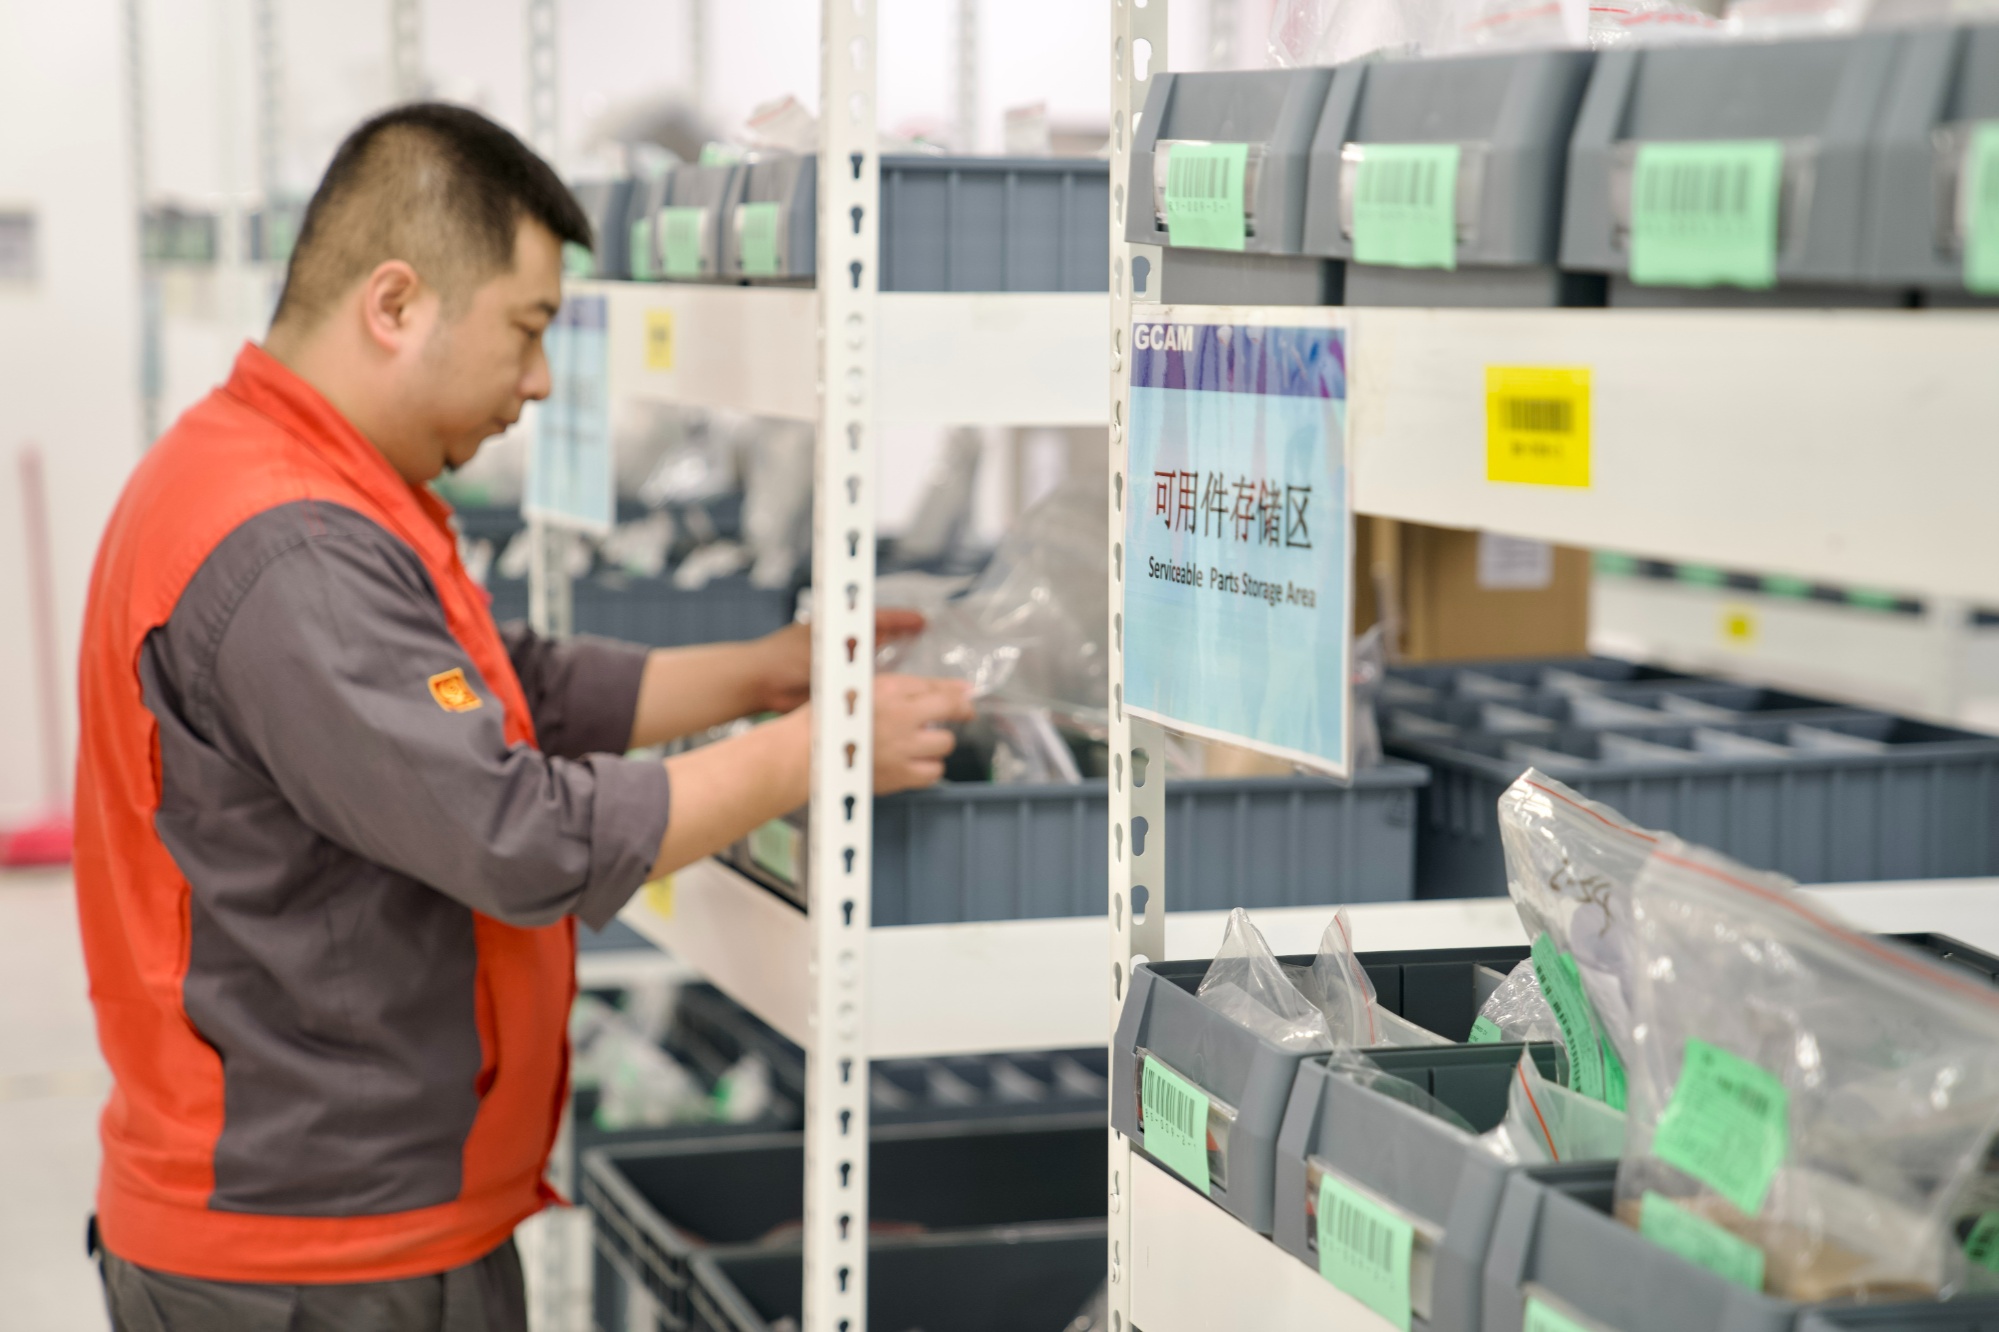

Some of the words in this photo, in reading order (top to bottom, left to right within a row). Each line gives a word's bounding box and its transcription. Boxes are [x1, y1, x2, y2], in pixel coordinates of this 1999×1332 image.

[1134, 323, 1194, 352] GCAM
[1154, 469, 1312, 549] 可用件存储区
[1148, 555, 1203, 587] Serviceable
[1210, 566, 1239, 594] Parts
[1241, 572, 1283, 606] Storage
[1286, 580, 1317, 608] Area
